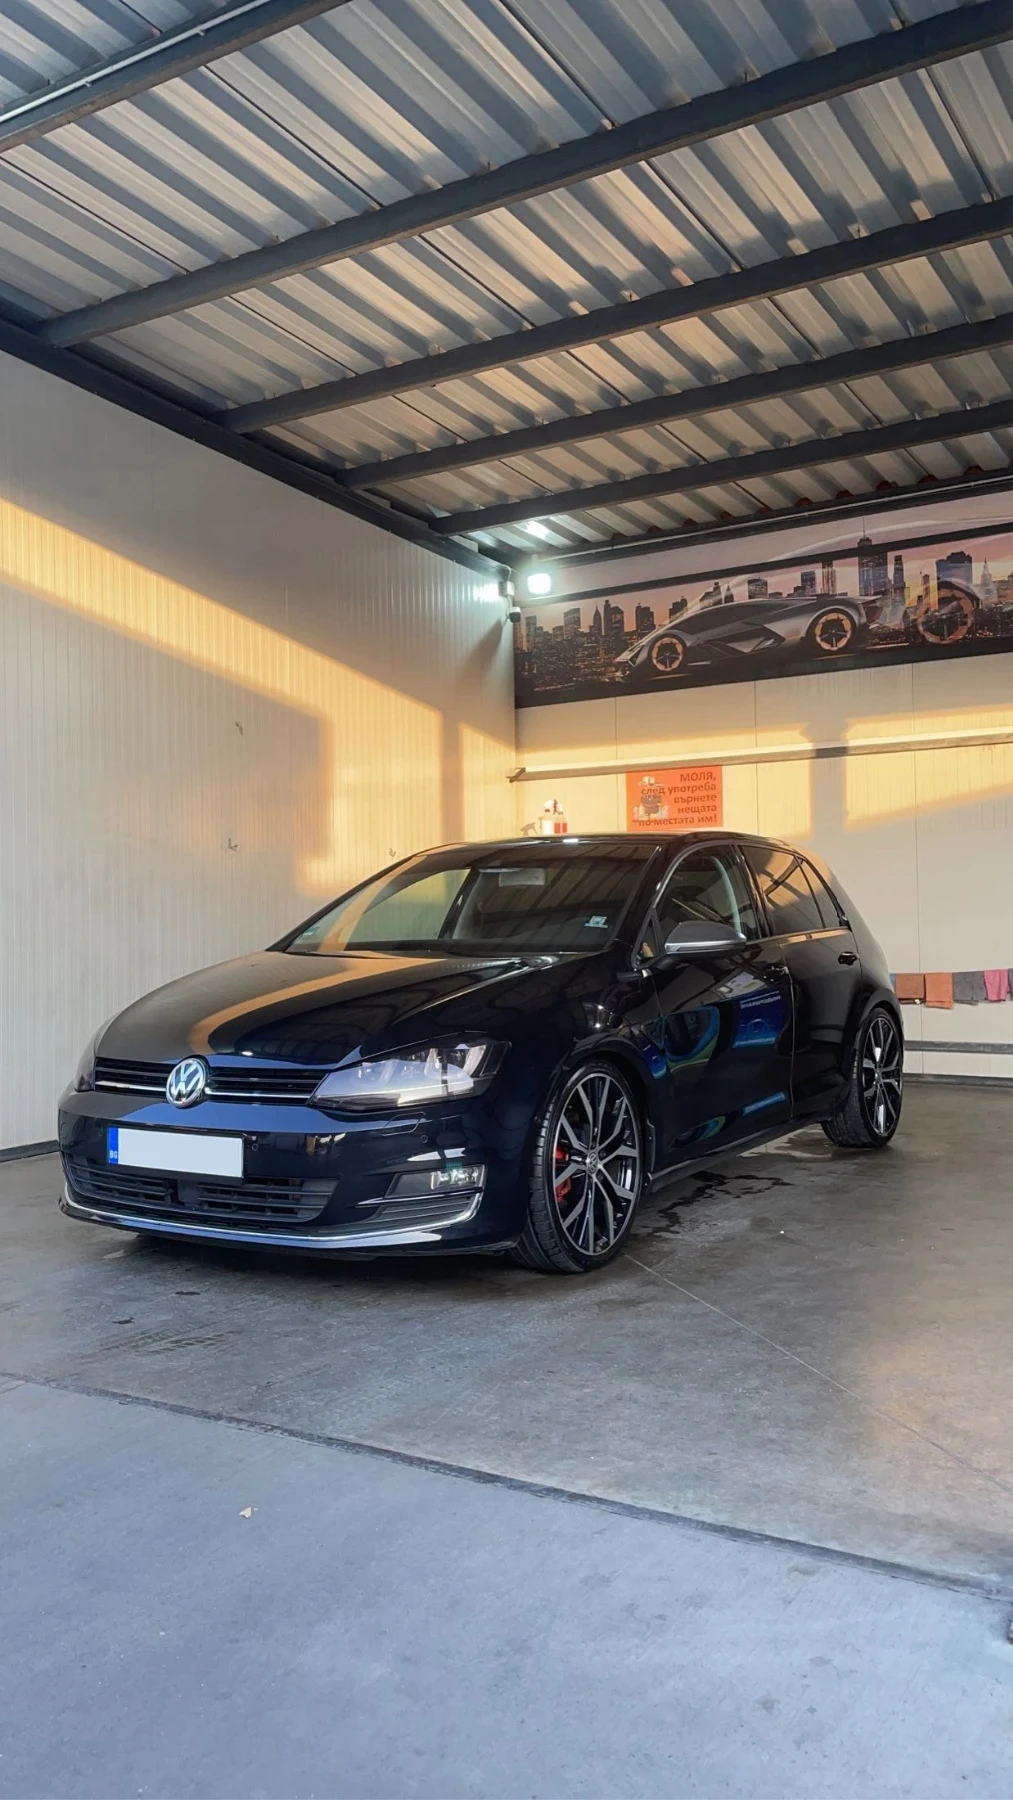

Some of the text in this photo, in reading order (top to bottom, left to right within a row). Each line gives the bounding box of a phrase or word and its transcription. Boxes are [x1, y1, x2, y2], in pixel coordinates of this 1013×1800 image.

[680, 772, 716, 782] МОЛЯ,
[641, 782, 716, 795] след употреба
[673, 794, 717, 804] върнете
[677, 804, 717, 814] нещата
[653, 817, 694, 826] местата
[697, 813, 717, 823] им!
[168, 1059, 205, 1106] VW
[109, 1150, 118, 1159] BG
